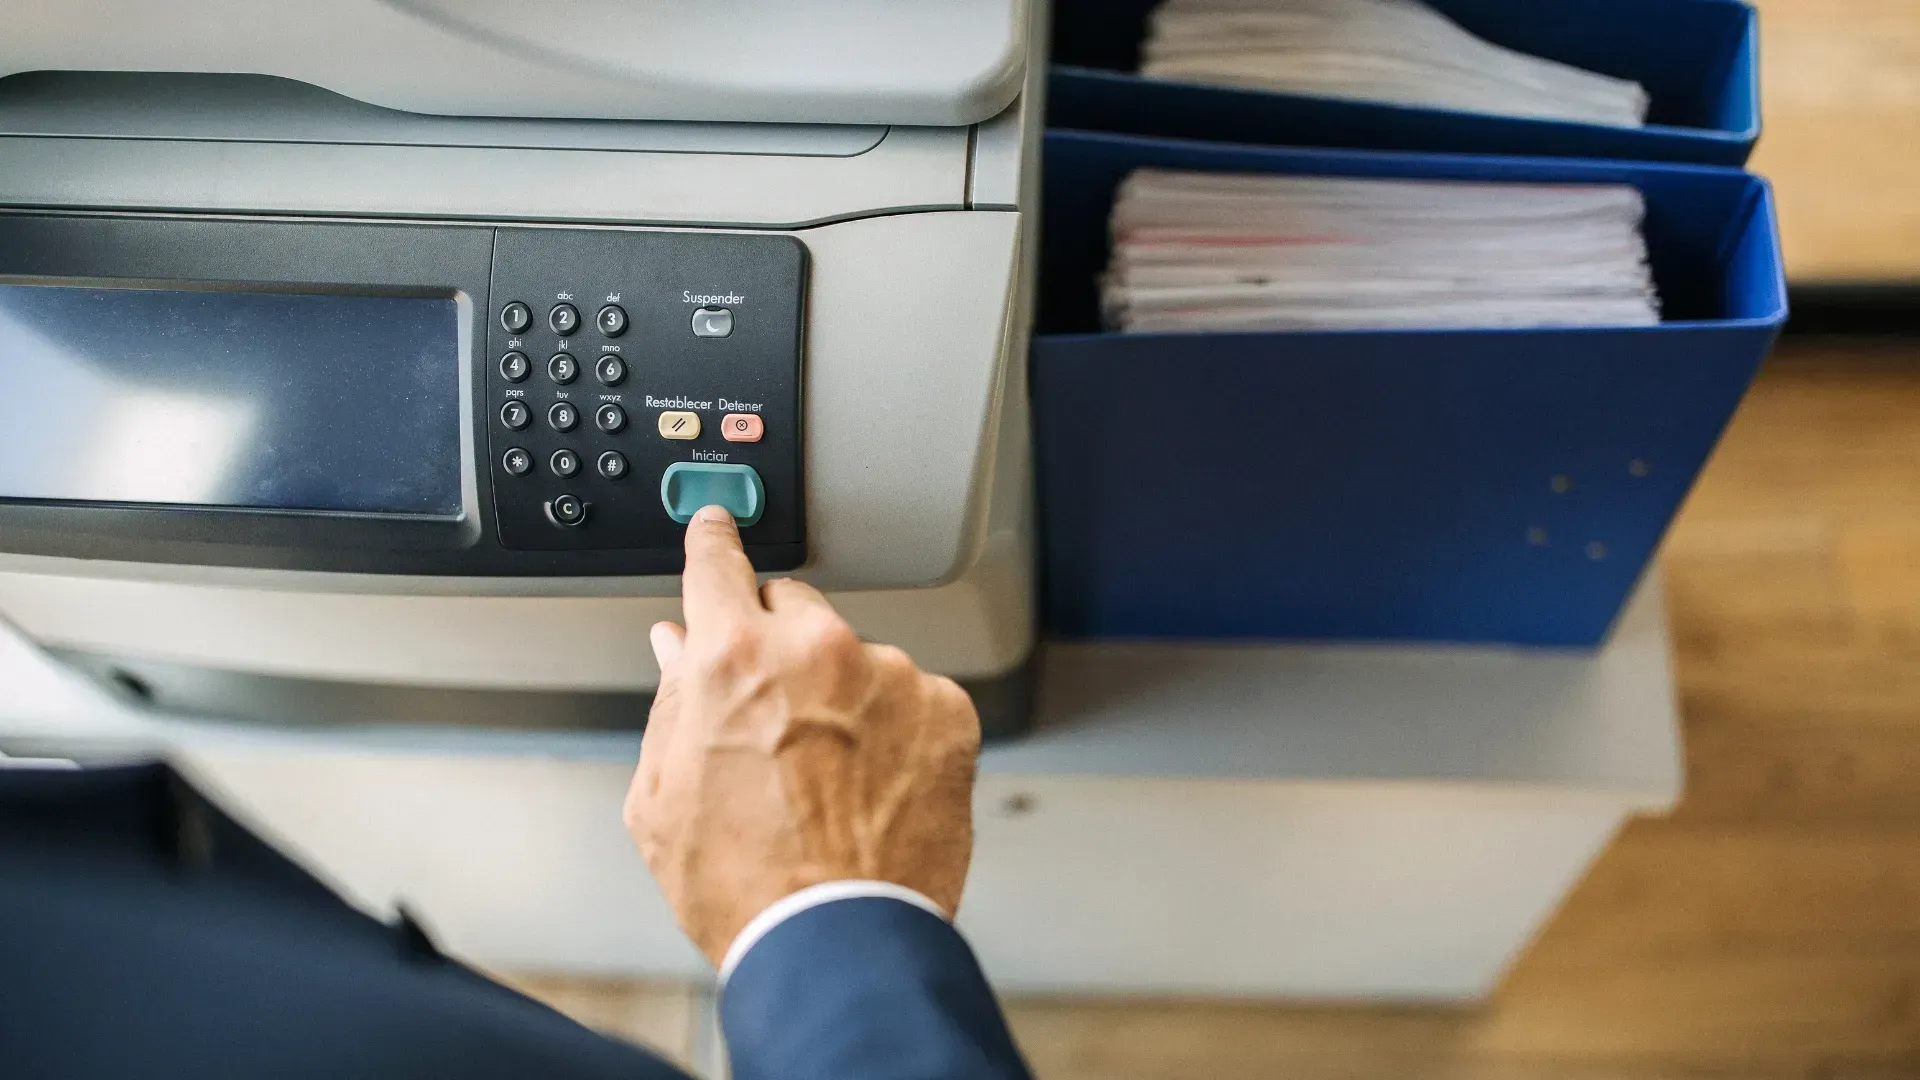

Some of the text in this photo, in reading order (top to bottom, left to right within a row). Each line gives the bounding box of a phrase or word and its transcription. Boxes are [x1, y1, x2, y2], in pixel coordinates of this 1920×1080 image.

[557, 291, 574, 301] abc
[606, 292, 621, 302] def
[682, 290, 745, 307] Suspender
[513, 309, 519, 322] 1
[559, 311, 568, 324] 2
[607, 312, 616, 326] 3
[508, 337, 522, 349] ghi
[558, 340, 568, 351] jkl
[509, 358, 519, 371] 4
[558, 360, 567, 373] 5
[606, 363, 615, 375] 6
[505, 389, 524, 398] pqrs
[599, 394, 622, 403] wxyz
[645, 395, 713, 410] Restablecer
[718, 398, 763, 412] Detener
[510, 408, 519, 421] 7
[559, 409, 568, 422] 8
[606, 411, 615, 424] 9
[692, 449, 729, 462] Iniciar
[560, 457, 570, 469] 0
